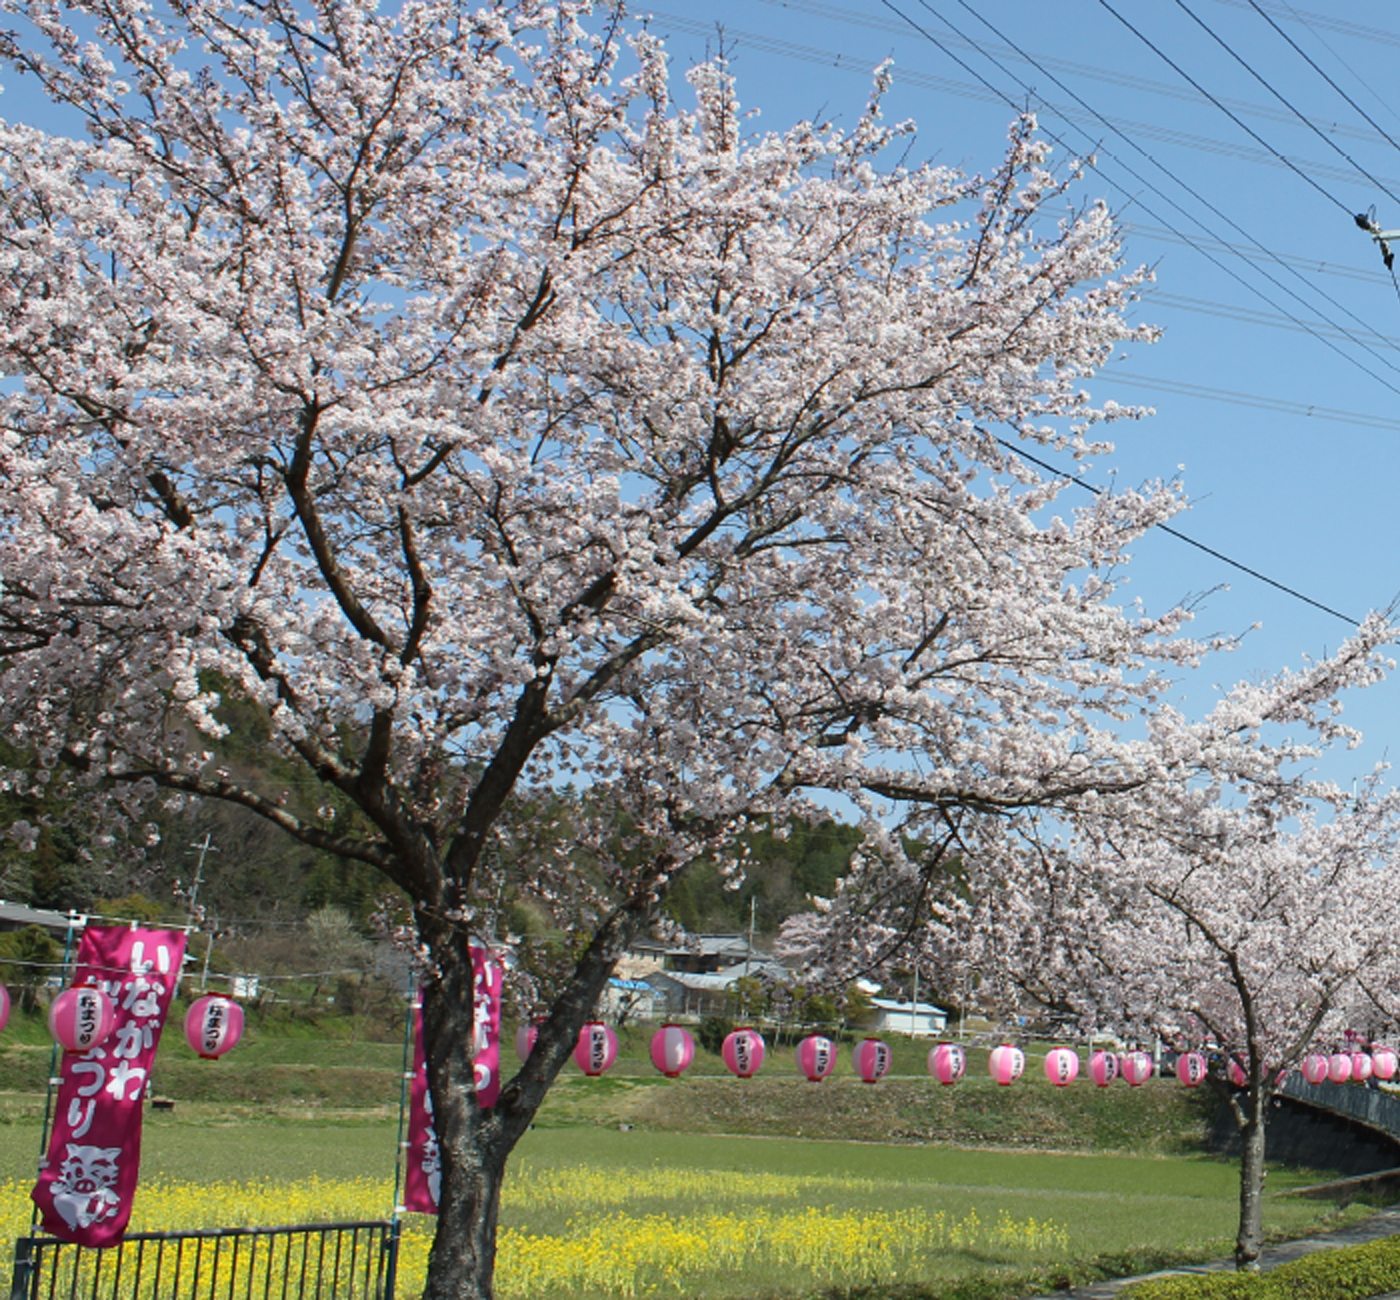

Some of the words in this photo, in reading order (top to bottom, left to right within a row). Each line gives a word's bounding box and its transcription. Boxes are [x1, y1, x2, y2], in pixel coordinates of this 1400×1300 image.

[79, 996, 97, 1044] 桜まつり
[106, 941, 170, 1100] いながわ
[206, 1005, 224, 1050] 桜まつり
